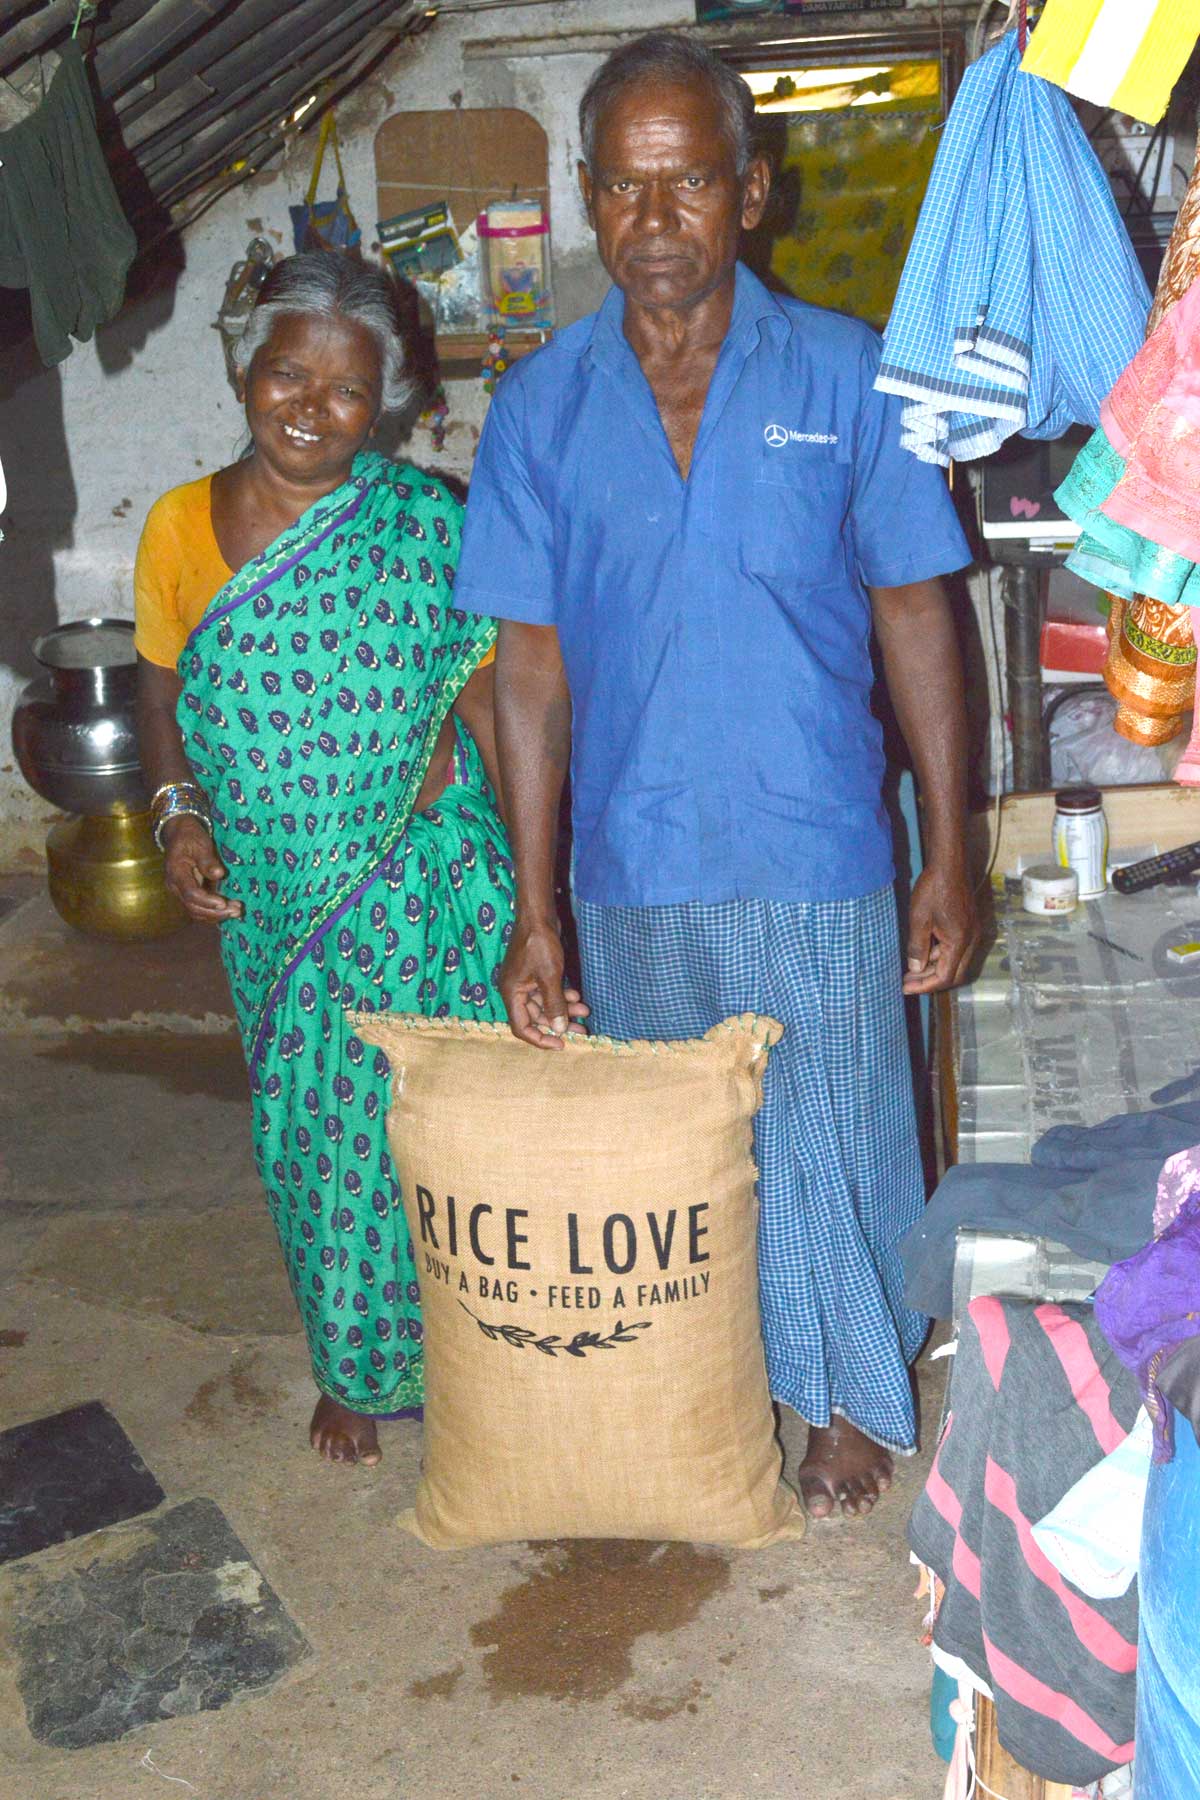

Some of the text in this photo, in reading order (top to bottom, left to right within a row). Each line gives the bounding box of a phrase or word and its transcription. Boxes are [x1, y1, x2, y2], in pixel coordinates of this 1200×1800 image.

[416, 1184, 710, 1275] RICE LOVE
[425, 1252, 710, 1309] BUY A BAG FEED A FAMILY
